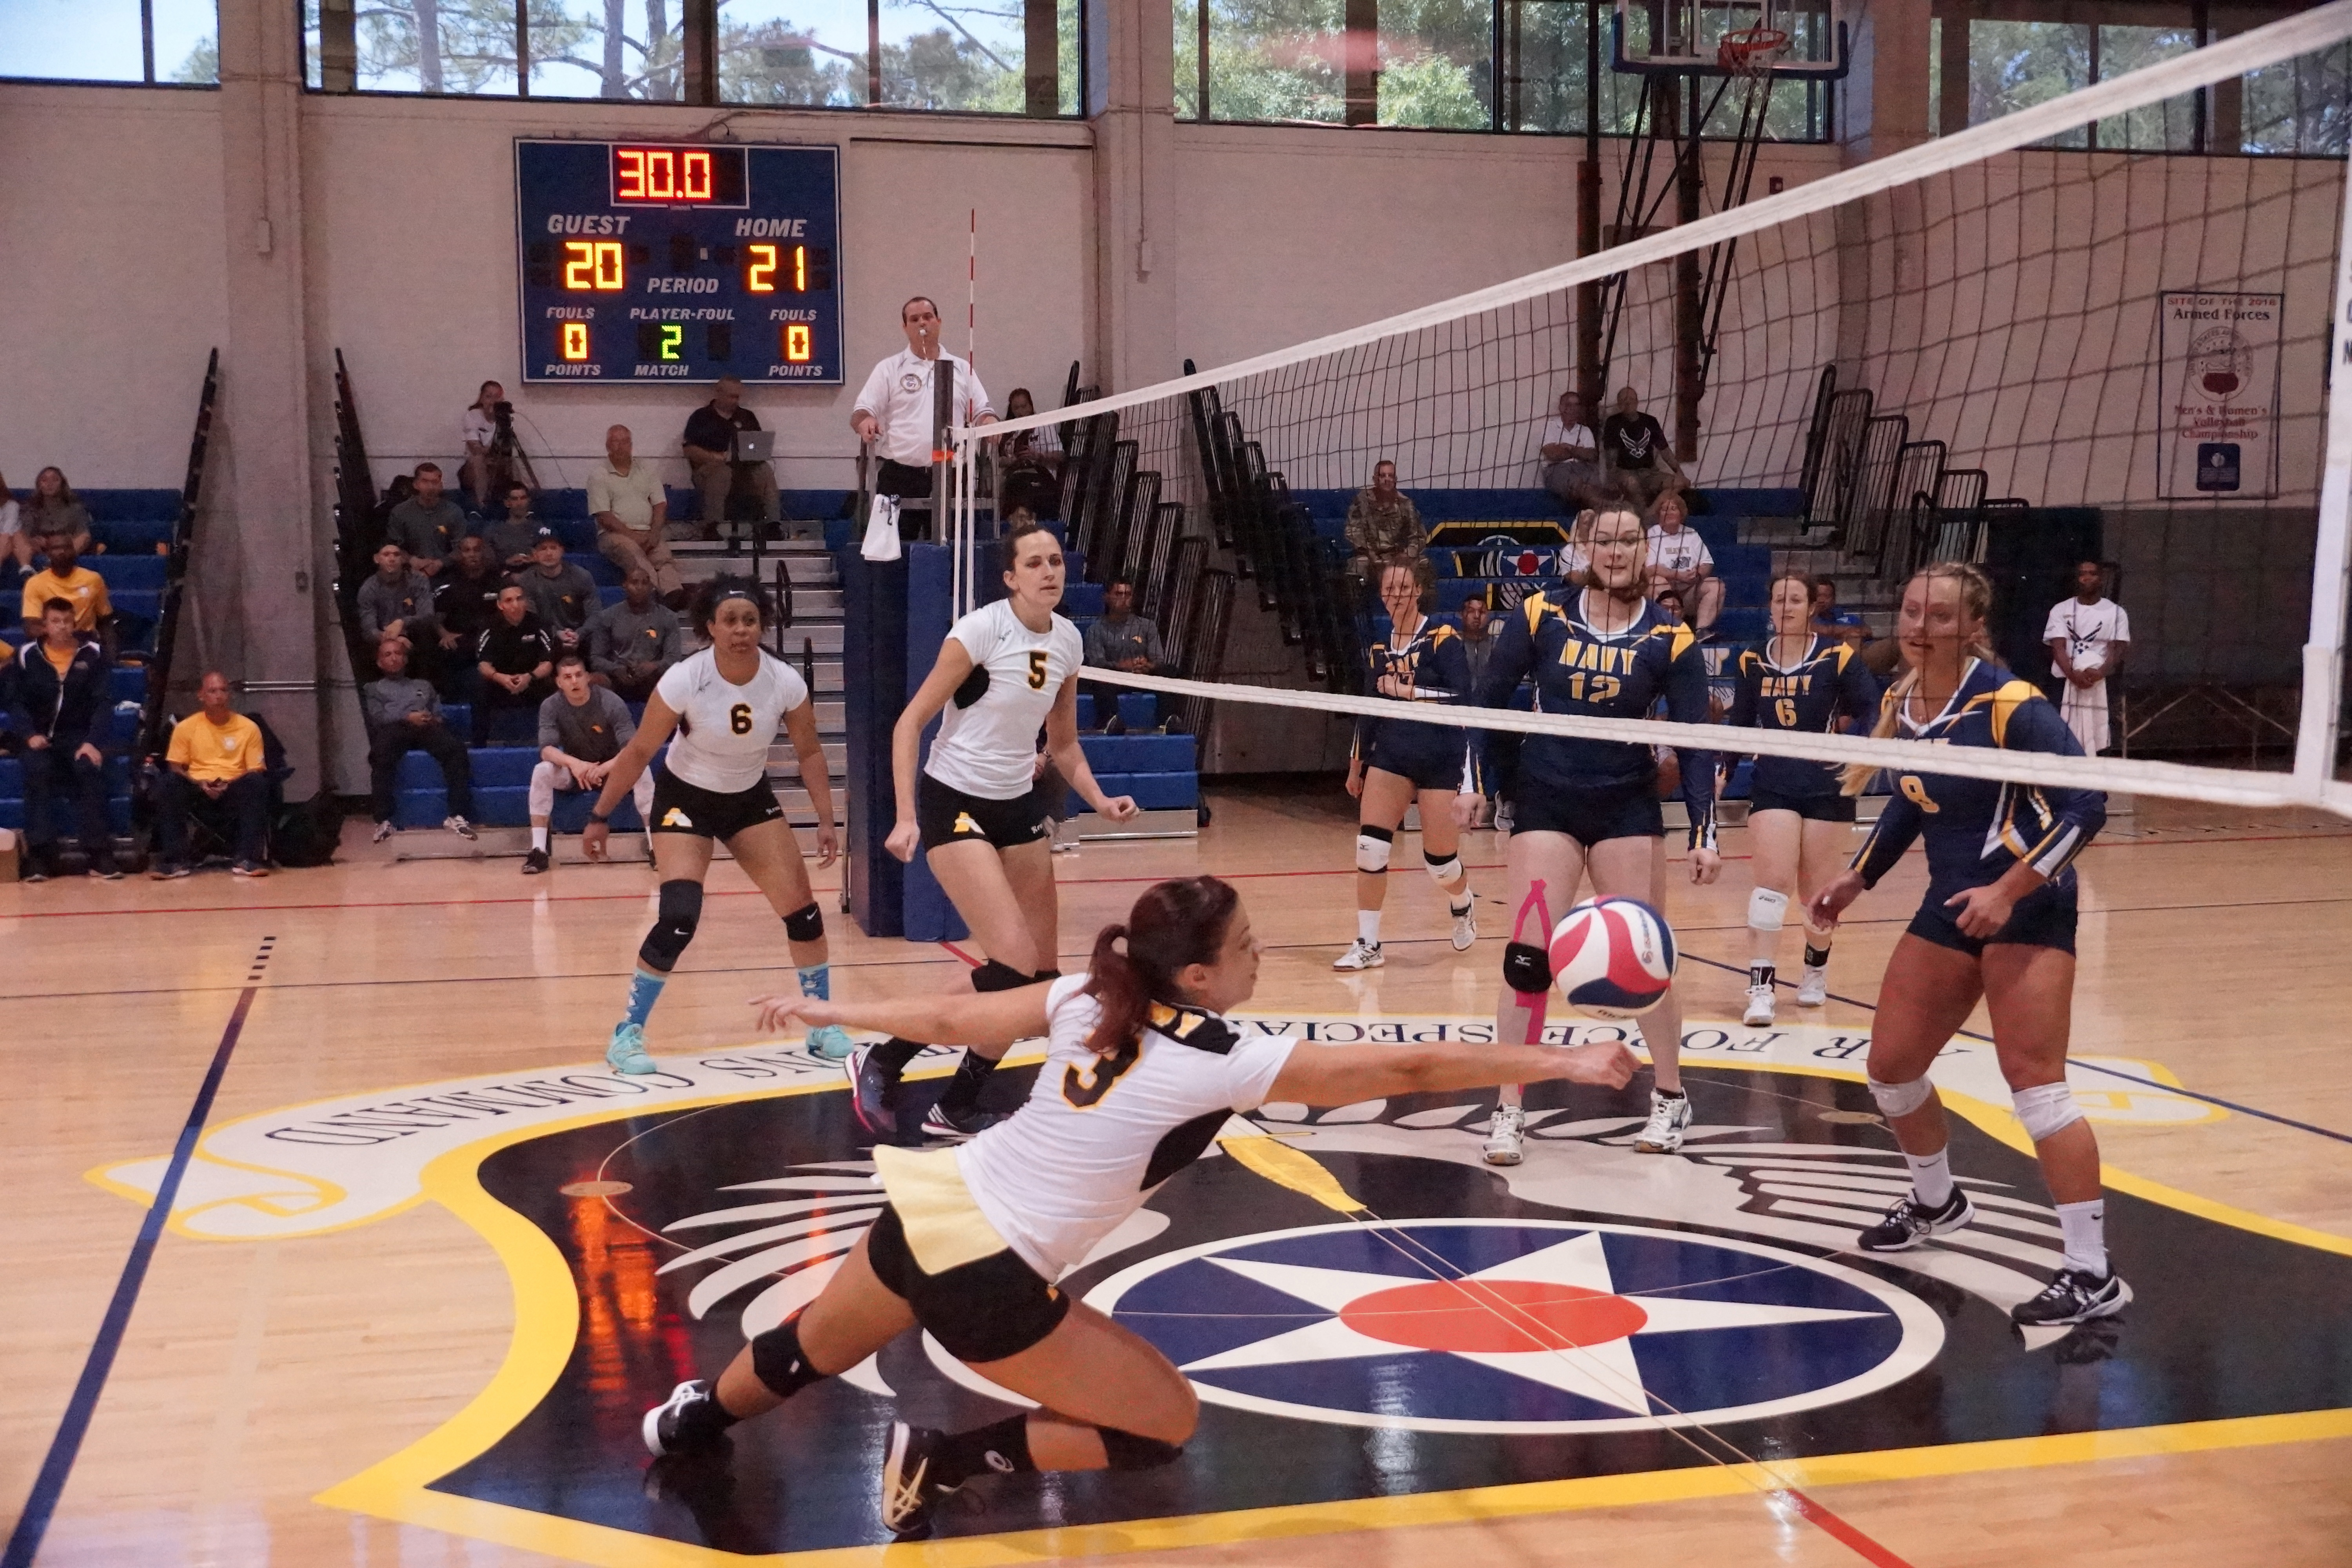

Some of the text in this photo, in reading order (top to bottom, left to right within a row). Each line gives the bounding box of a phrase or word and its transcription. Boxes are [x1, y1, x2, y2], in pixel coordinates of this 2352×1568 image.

[618, 150, 711, 199] 30.0
[548, 214, 630, 234] GUEST
[735, 218, 808, 238] HOME
[565, 241, 623, 289] 20
[749, 245, 805, 292] 21
[647, 278, 719, 294] PERIOD
[546, 307, 595, 319] FOULS
[630, 308, 735, 321] PLAYER-FOUL
[769, 309, 817, 322] FOULS
[2174, 309, 2270, 320] Armed Forces
[565, 323, 588, 359] 0
[661, 325, 682, 359] 2
[788, 325, 810, 361] 0
[545, 364, 602, 377] POINTS
[635, 365, 689, 377] MATCH
[768, 365, 823, 377] POINTS
[1558, 638, 1637, 675] NAVY
[1027, 650, 1048, 691] 5
[1568, 671, 1621, 703] 12
[1760, 675, 1812, 697] NAVY
[730, 702, 753, 736] 6
[1775, 698, 1797, 727] 6
[1228, 1020, 1494, 1044] SPECIA
[264, 1071, 695, 1147] COMMAND
